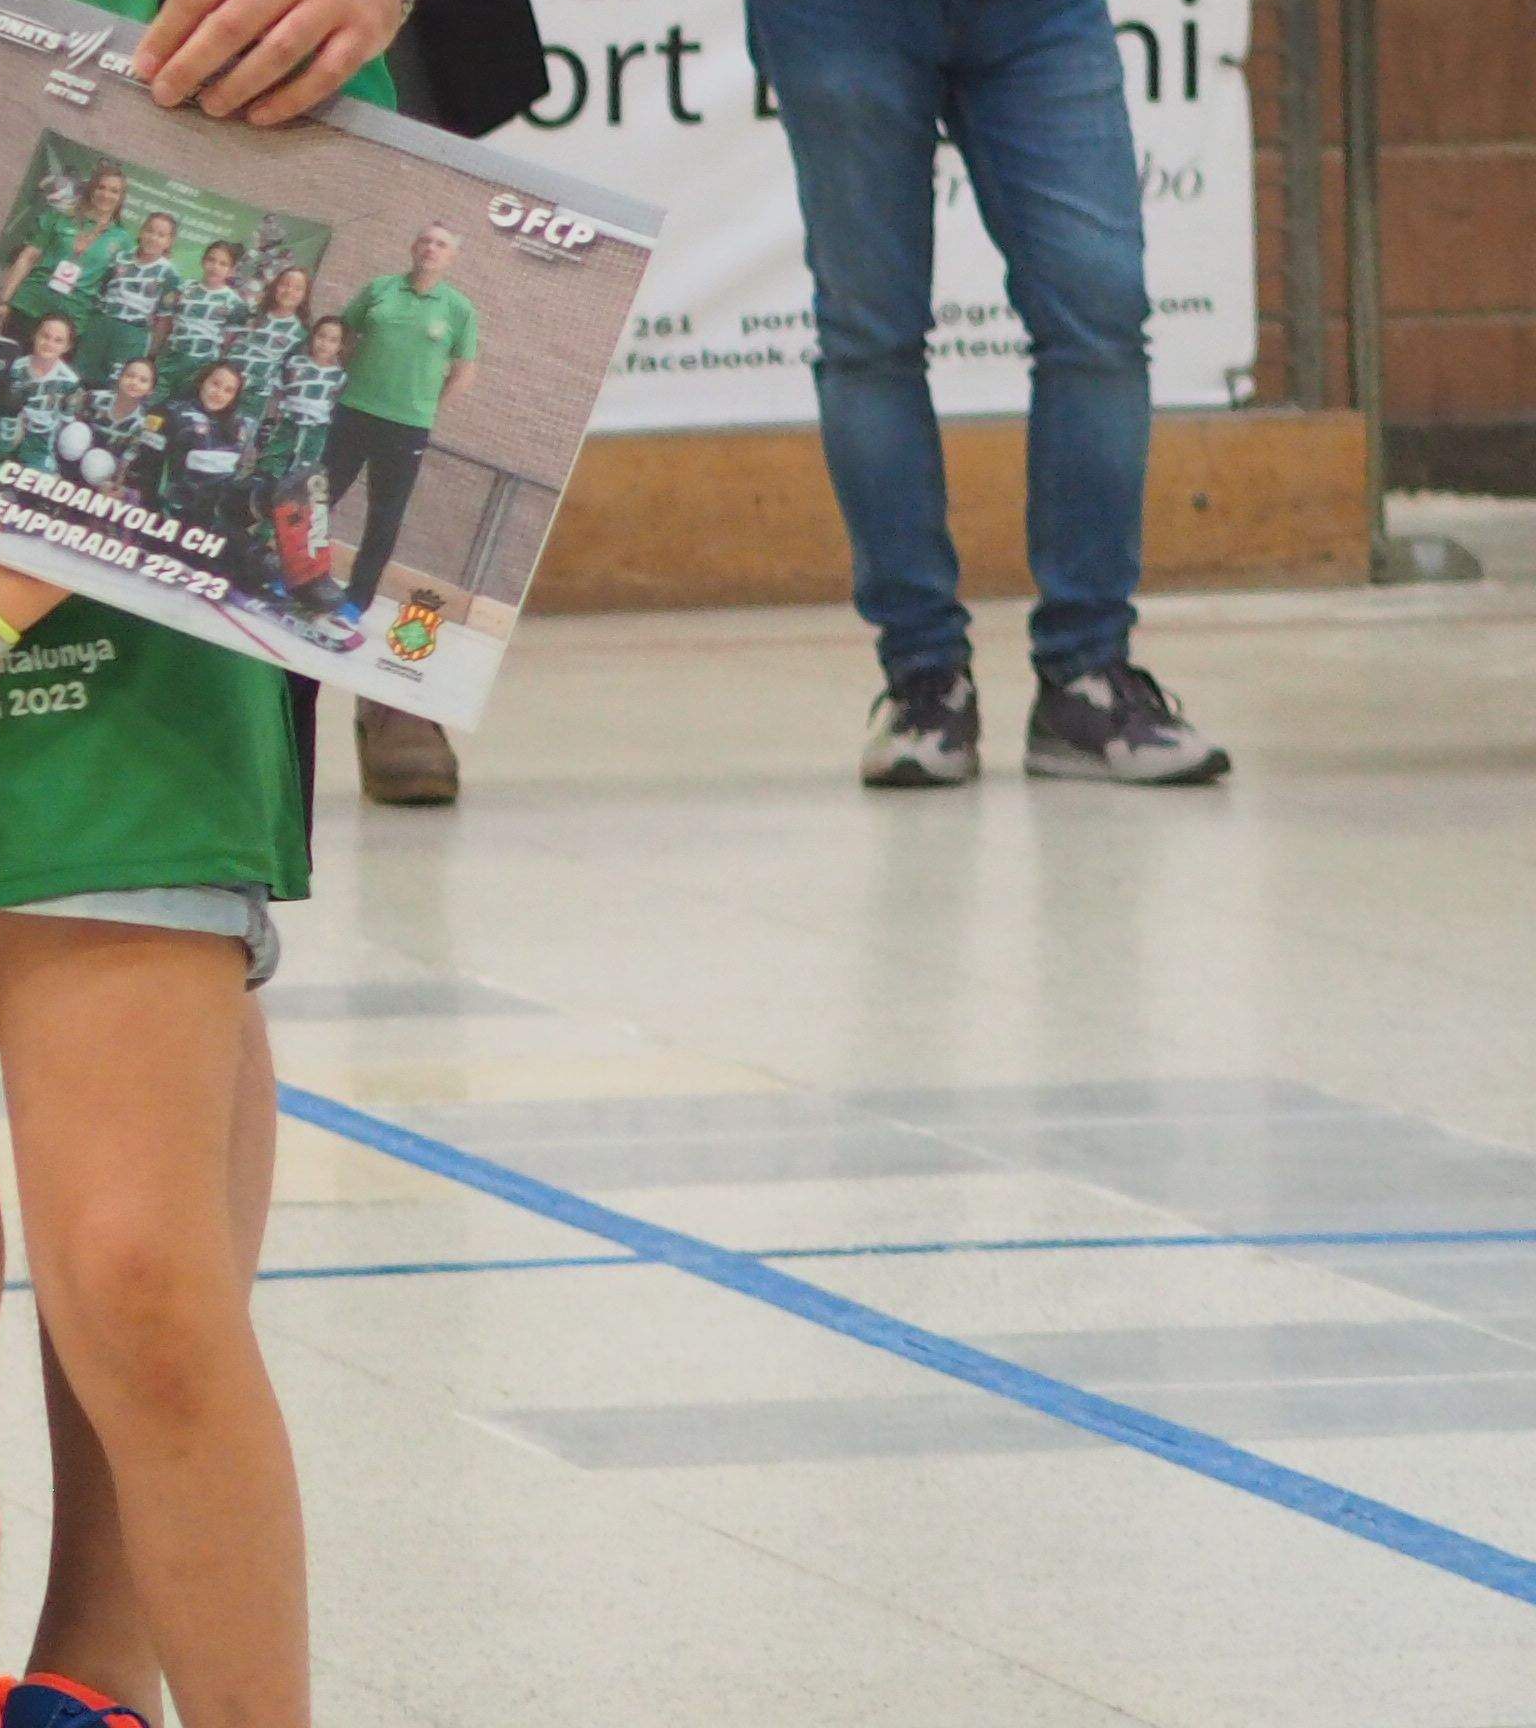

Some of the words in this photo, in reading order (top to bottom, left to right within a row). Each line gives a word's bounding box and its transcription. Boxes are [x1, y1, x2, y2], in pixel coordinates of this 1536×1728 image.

[520, 208, 595, 249] FCP
[181, 526, 226, 559] CH
[143, 552, 230, 602] 22-23
[9, 680, 87, 717] 2023
